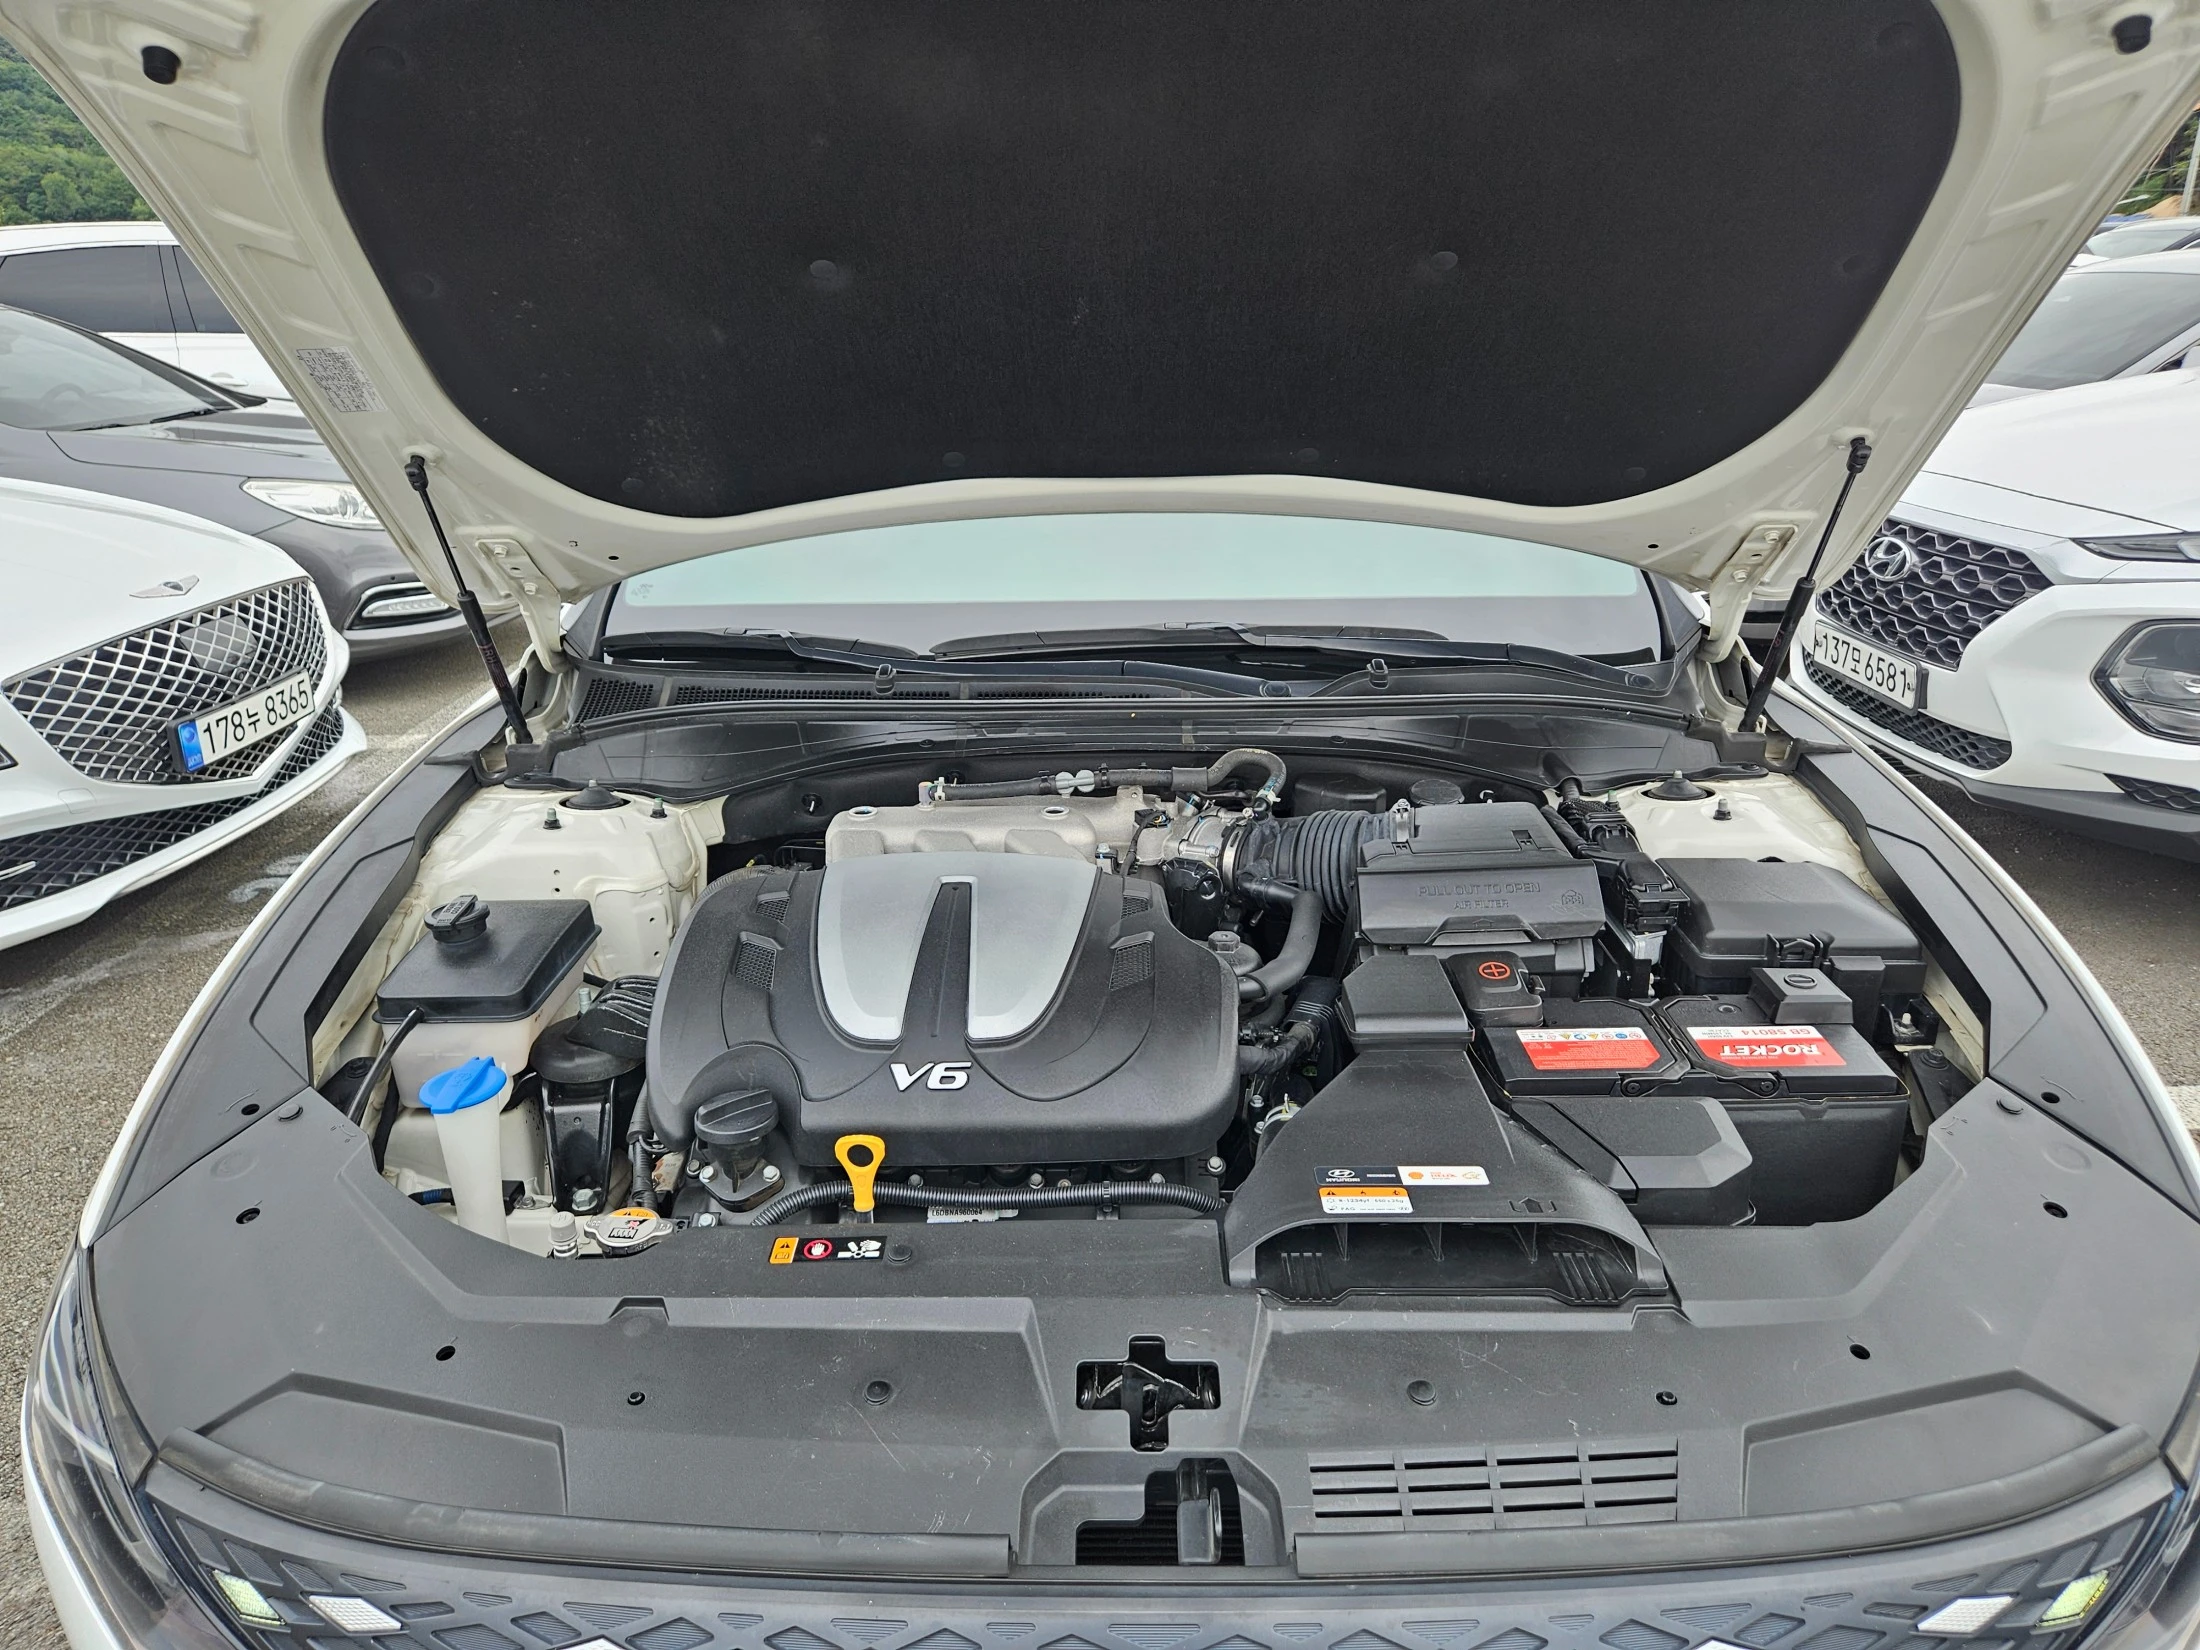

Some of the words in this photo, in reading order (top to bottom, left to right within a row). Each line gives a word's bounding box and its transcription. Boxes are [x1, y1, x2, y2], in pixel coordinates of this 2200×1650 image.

[1864, 652, 1907, 698] 6581
[264, 679, 309, 726] 8365
[1418, 886, 1452, 897] PULL
[1454, 884, 1480, 896] OUT
[1483, 883, 1502, 894] TO
[1505, 882, 1541, 894] OPEN
[1454, 900, 1472, 910] AIR
[1474, 899, 1509, 909] FILTER
[1741, 1028, 1786, 1036] 58014
[1719, 1044, 1823, 1057] ROCKET
[889, 1062, 973, 1092] V6
